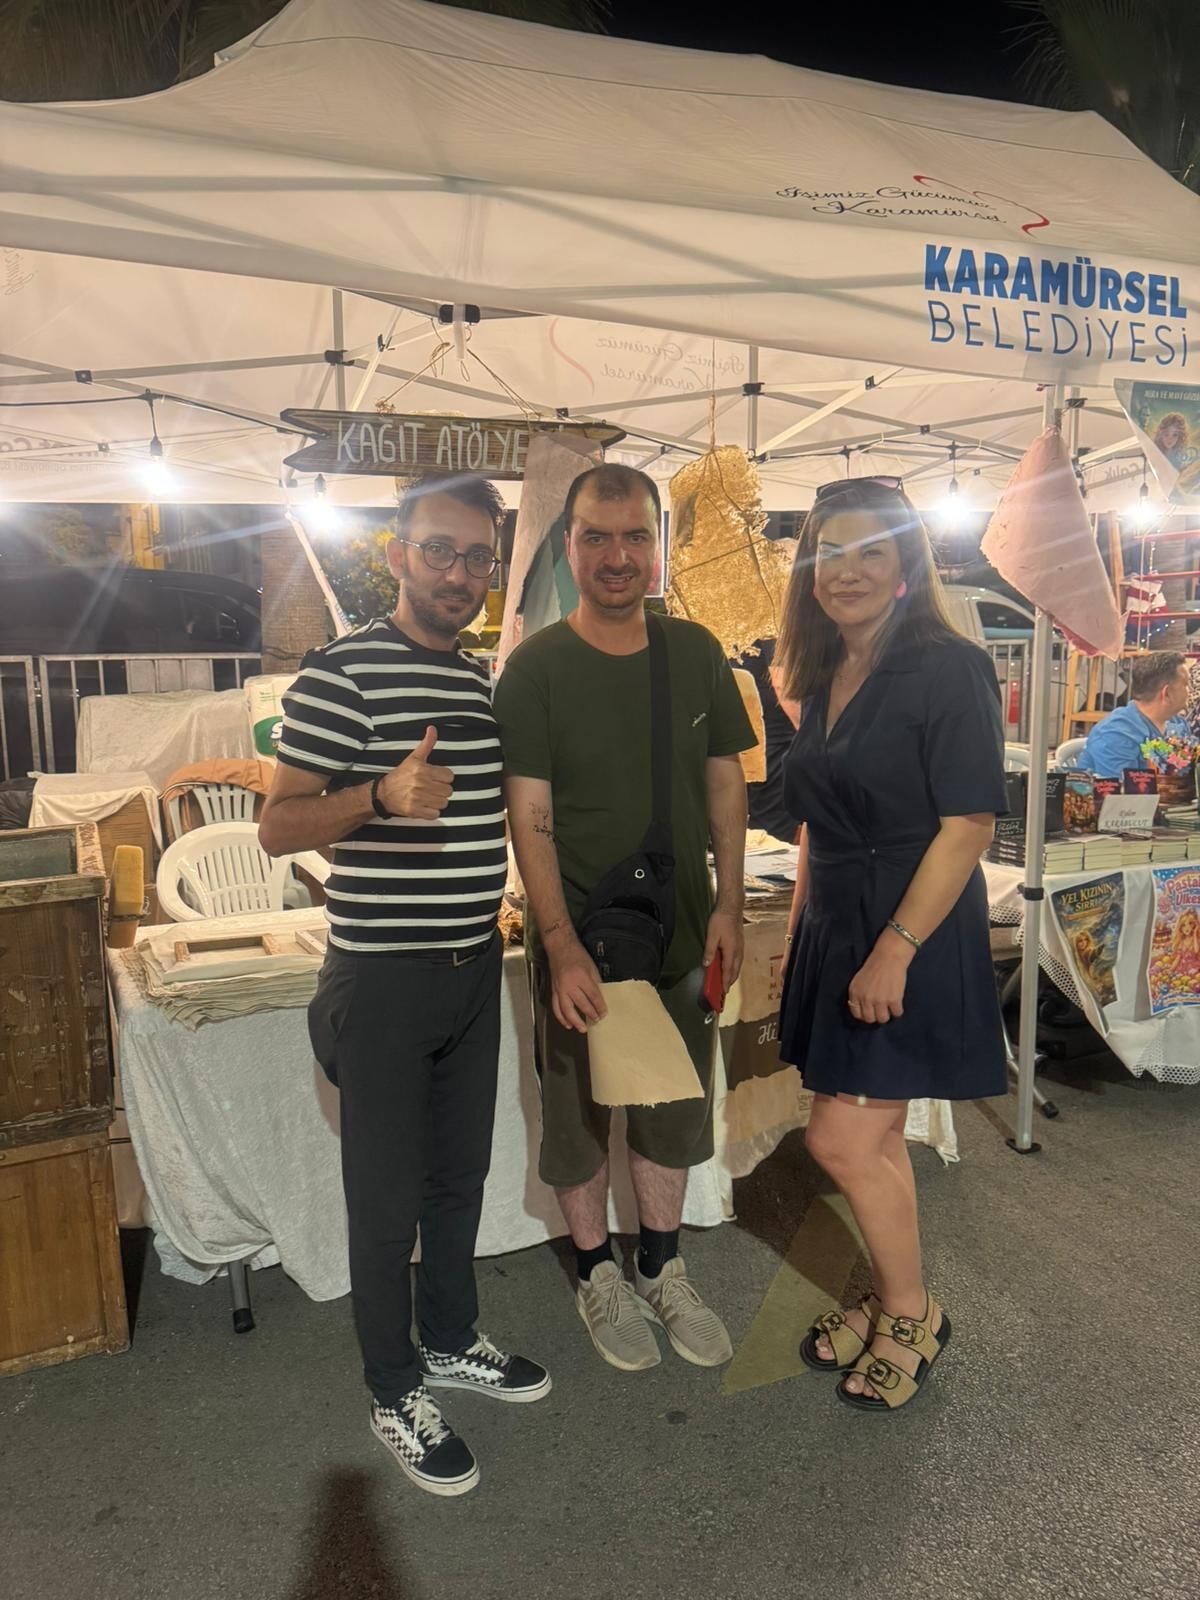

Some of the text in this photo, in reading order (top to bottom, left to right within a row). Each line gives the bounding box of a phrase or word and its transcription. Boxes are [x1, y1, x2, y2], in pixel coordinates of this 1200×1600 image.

[924, 243, 1187, 318] KARAMÜRSEL
[337, 416, 530, 475] KAĞIT ATÖLYE
